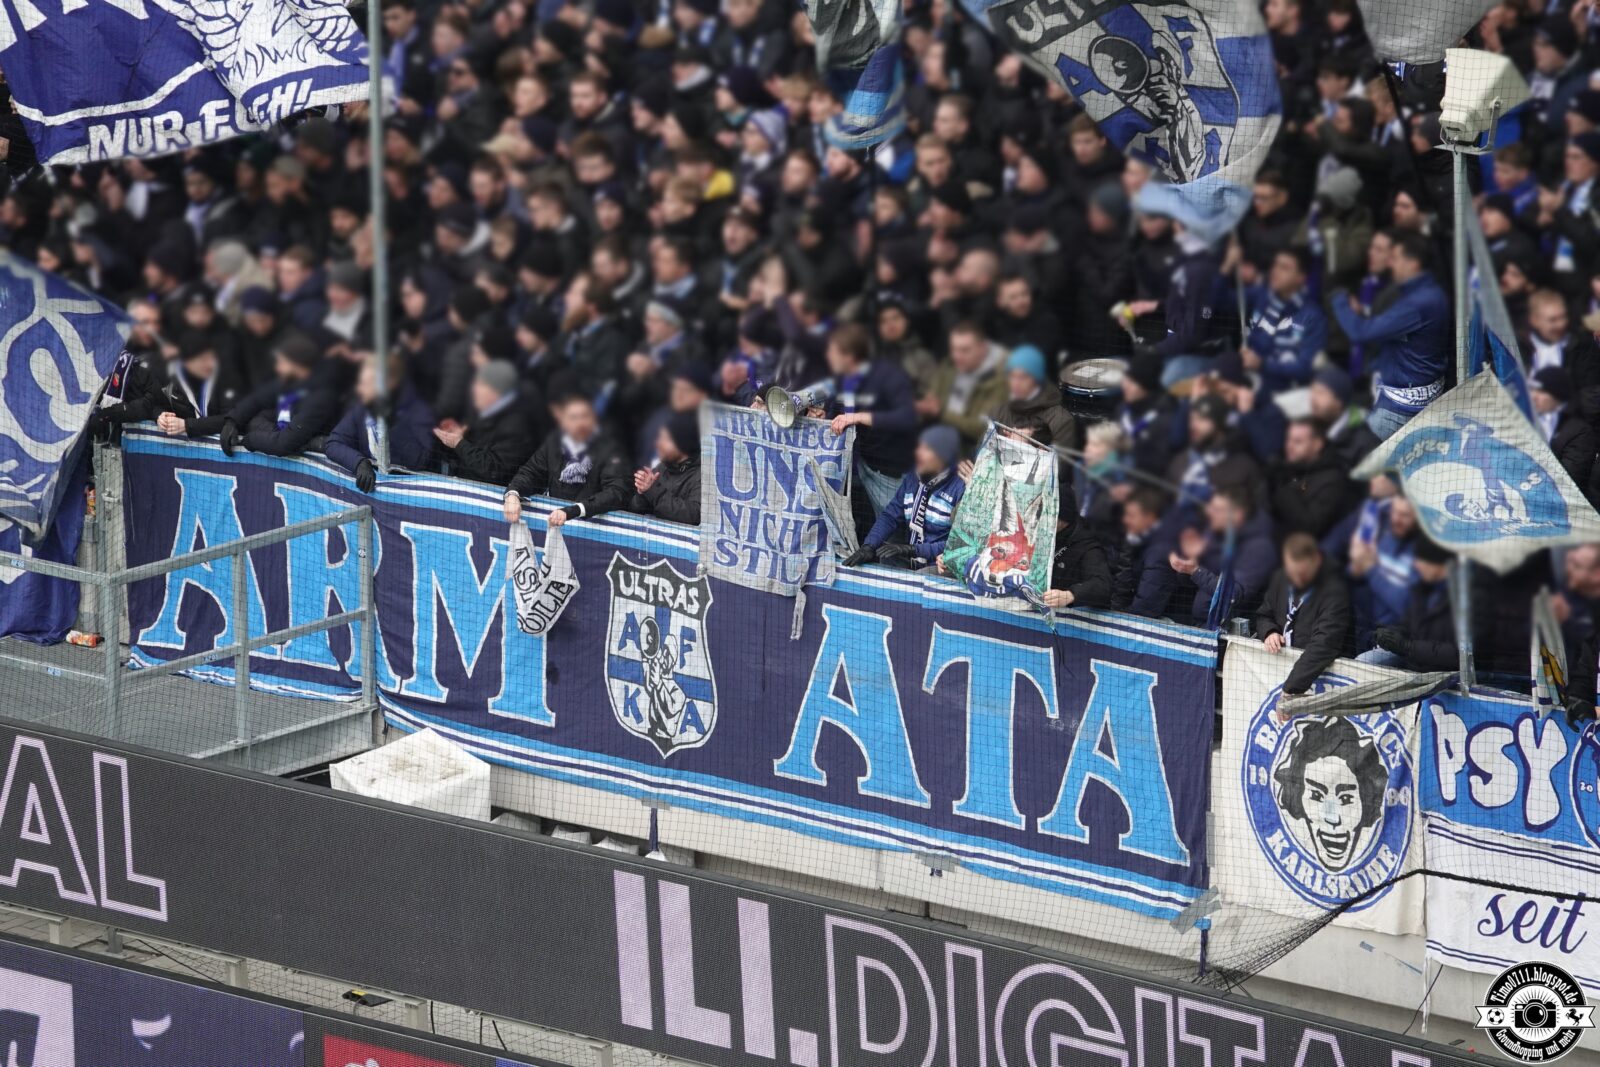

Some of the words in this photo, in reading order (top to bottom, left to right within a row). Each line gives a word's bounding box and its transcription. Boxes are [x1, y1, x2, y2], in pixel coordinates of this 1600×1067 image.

[88, 110, 188, 158] NUR
[718, 499, 829, 553] NICHT
[714, 539, 831, 585] STILL
[618, 570, 700, 615] ULTRAS
[1264, 828, 1399, 899] KARLSRUHE
[1477, 891, 1588, 954] seit
